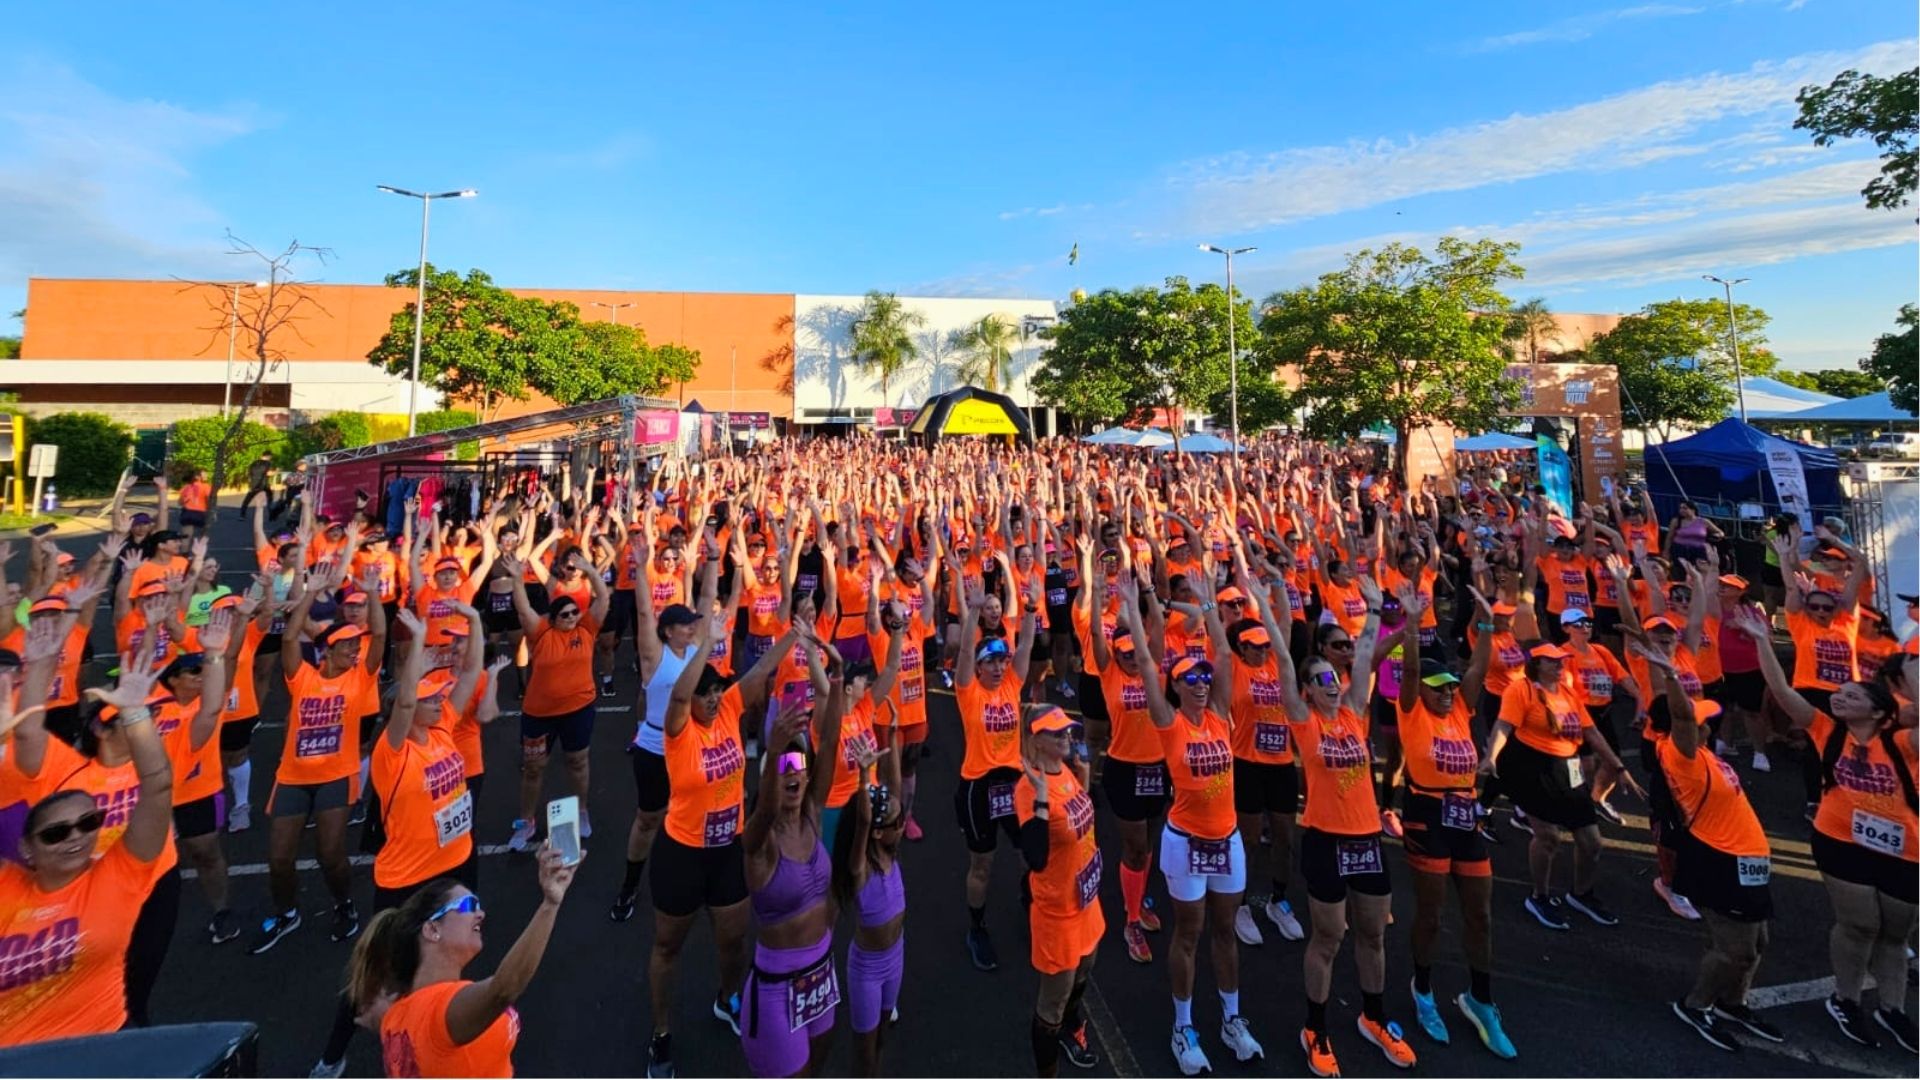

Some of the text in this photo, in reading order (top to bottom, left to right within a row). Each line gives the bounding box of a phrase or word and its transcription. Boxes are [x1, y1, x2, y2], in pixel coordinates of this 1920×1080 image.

[299, 736, 337, 751] 5440
[1260, 732, 1285, 745] 5522
[1135, 776, 1163, 788] 5344
[991, 793, 1015, 809] 535
[443, 806, 471, 834] 3027
[706, 818, 737, 838] 5586
[1853, 821, 1901, 847] 3043
[1191, 850, 1226, 866] 5349
[1342, 849, 1375, 865] 5348
[796, 976, 832, 1014] 5490
